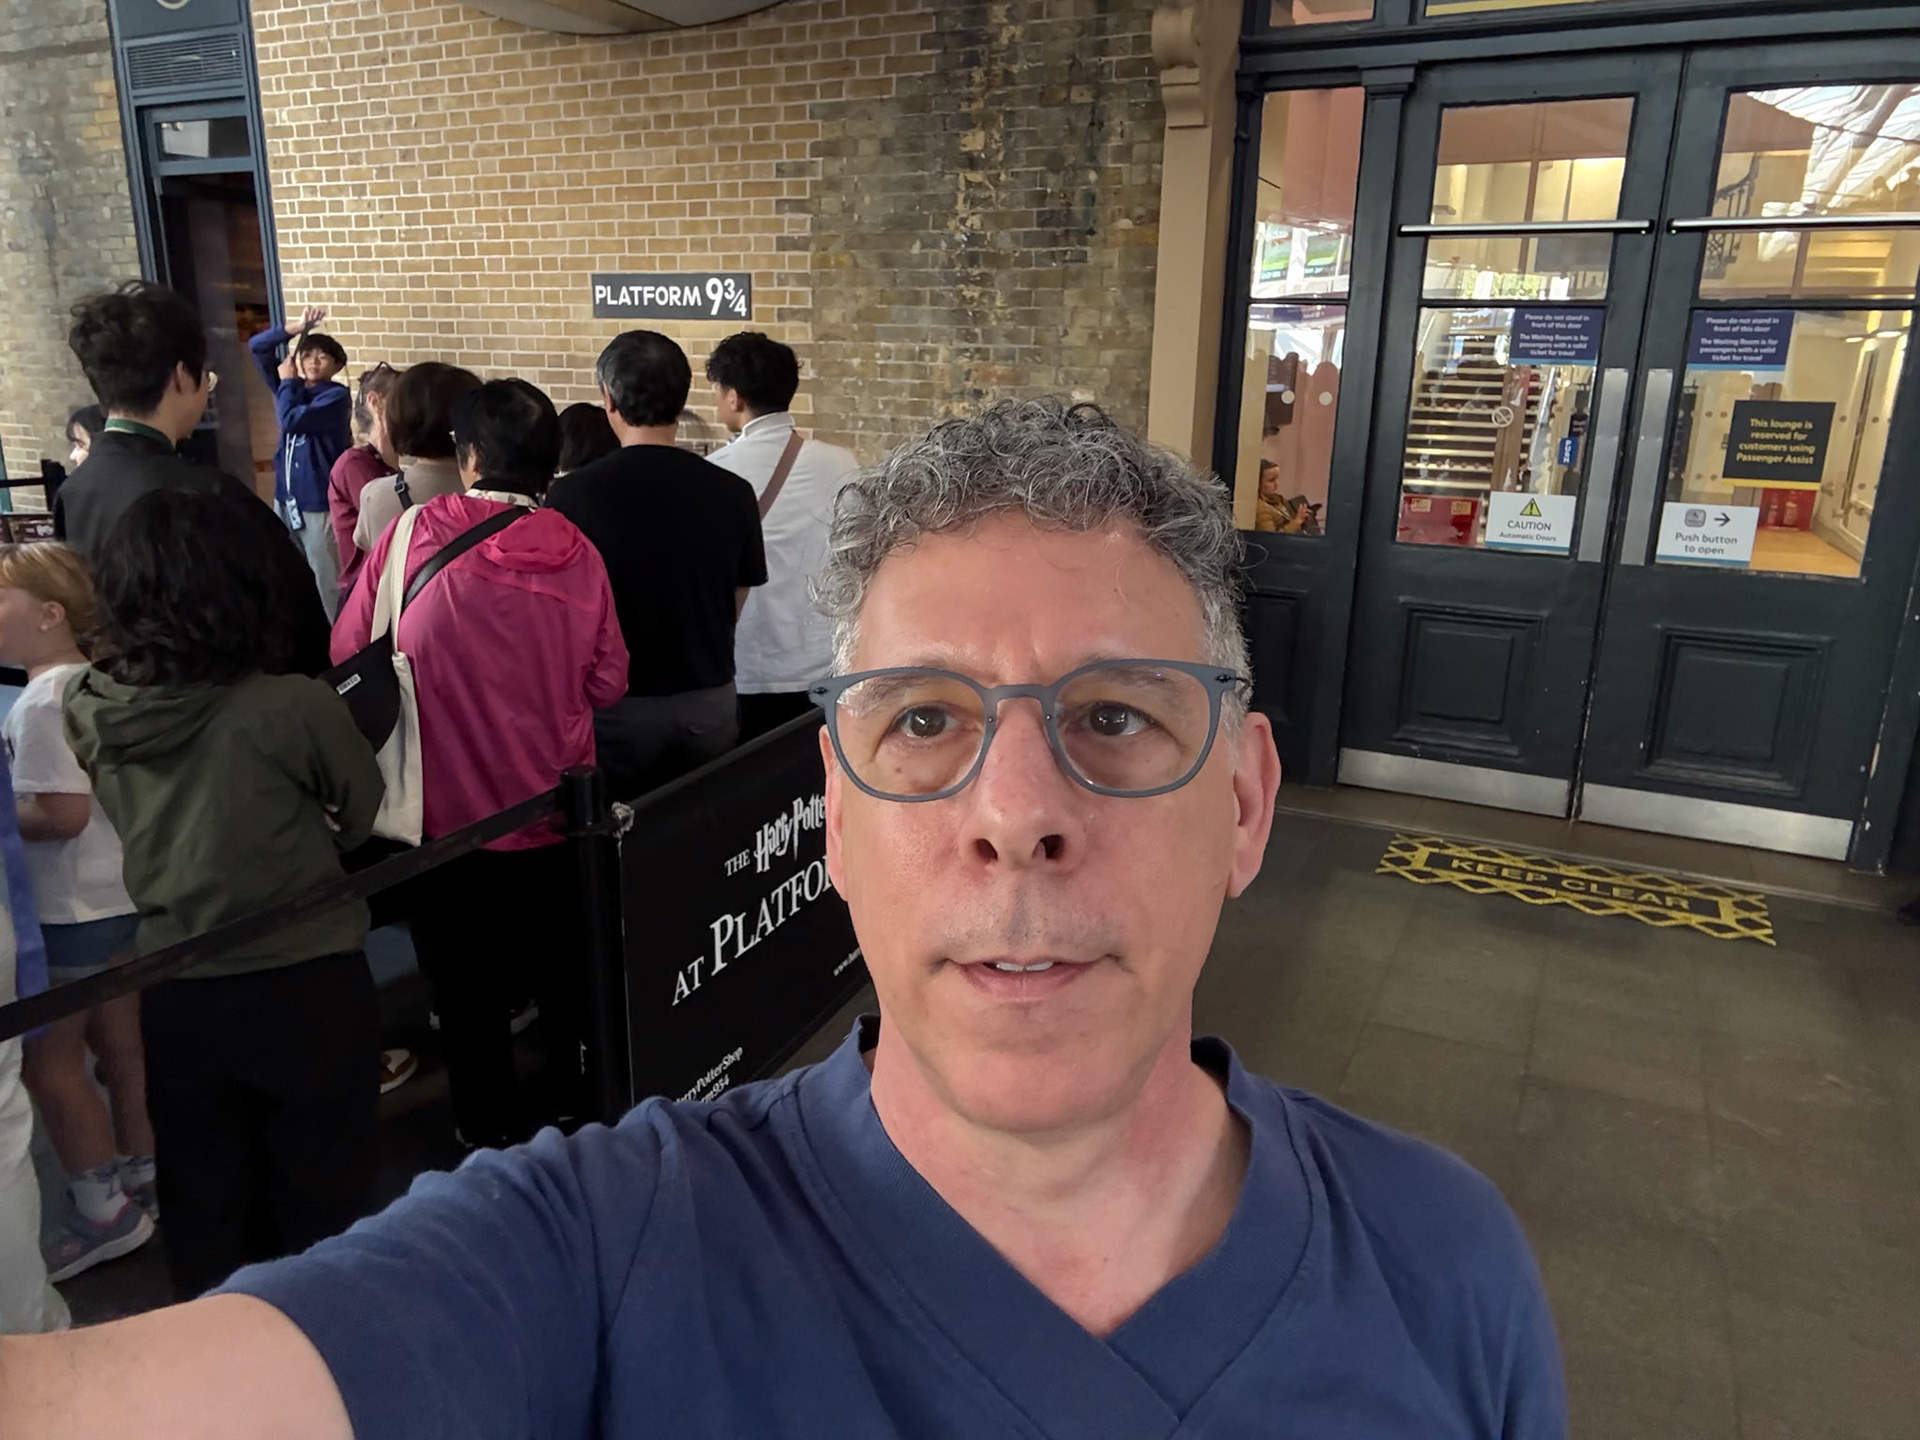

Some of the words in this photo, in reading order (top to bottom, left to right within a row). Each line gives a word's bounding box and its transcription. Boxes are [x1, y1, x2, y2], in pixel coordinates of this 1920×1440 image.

[595, 285, 702, 306] PLATFORM
[1750, 418, 1768, 427] This
[1770, 419, 1803, 430] lounge
[1804, 421, 1813, 429] is
[1750, 431, 1792, 440] reserved
[1793, 431, 1808, 440] for
[1739, 443, 1787, 451] customers
[1789, 445, 1816, 454] using
[1736, 452, 1783, 464] Passenger
[1784, 455, 1814, 464] Assist
[1507, 520, 1552, 531] CAUTION
[1499, 532, 1534, 540] Automatic
[1675, 532, 1699, 542] Push
[1702, 534, 1738, 544] button
[1698, 546, 1724, 555] open
[724, 848, 750, 877] THE
[753, 811, 793, 873] Harry
[792, 793, 827, 861] Potte
[1451, 859, 1548, 882] KEEP
[1561, 879, 1690, 910] CLEAR
[671, 956, 705, 1007] AT
